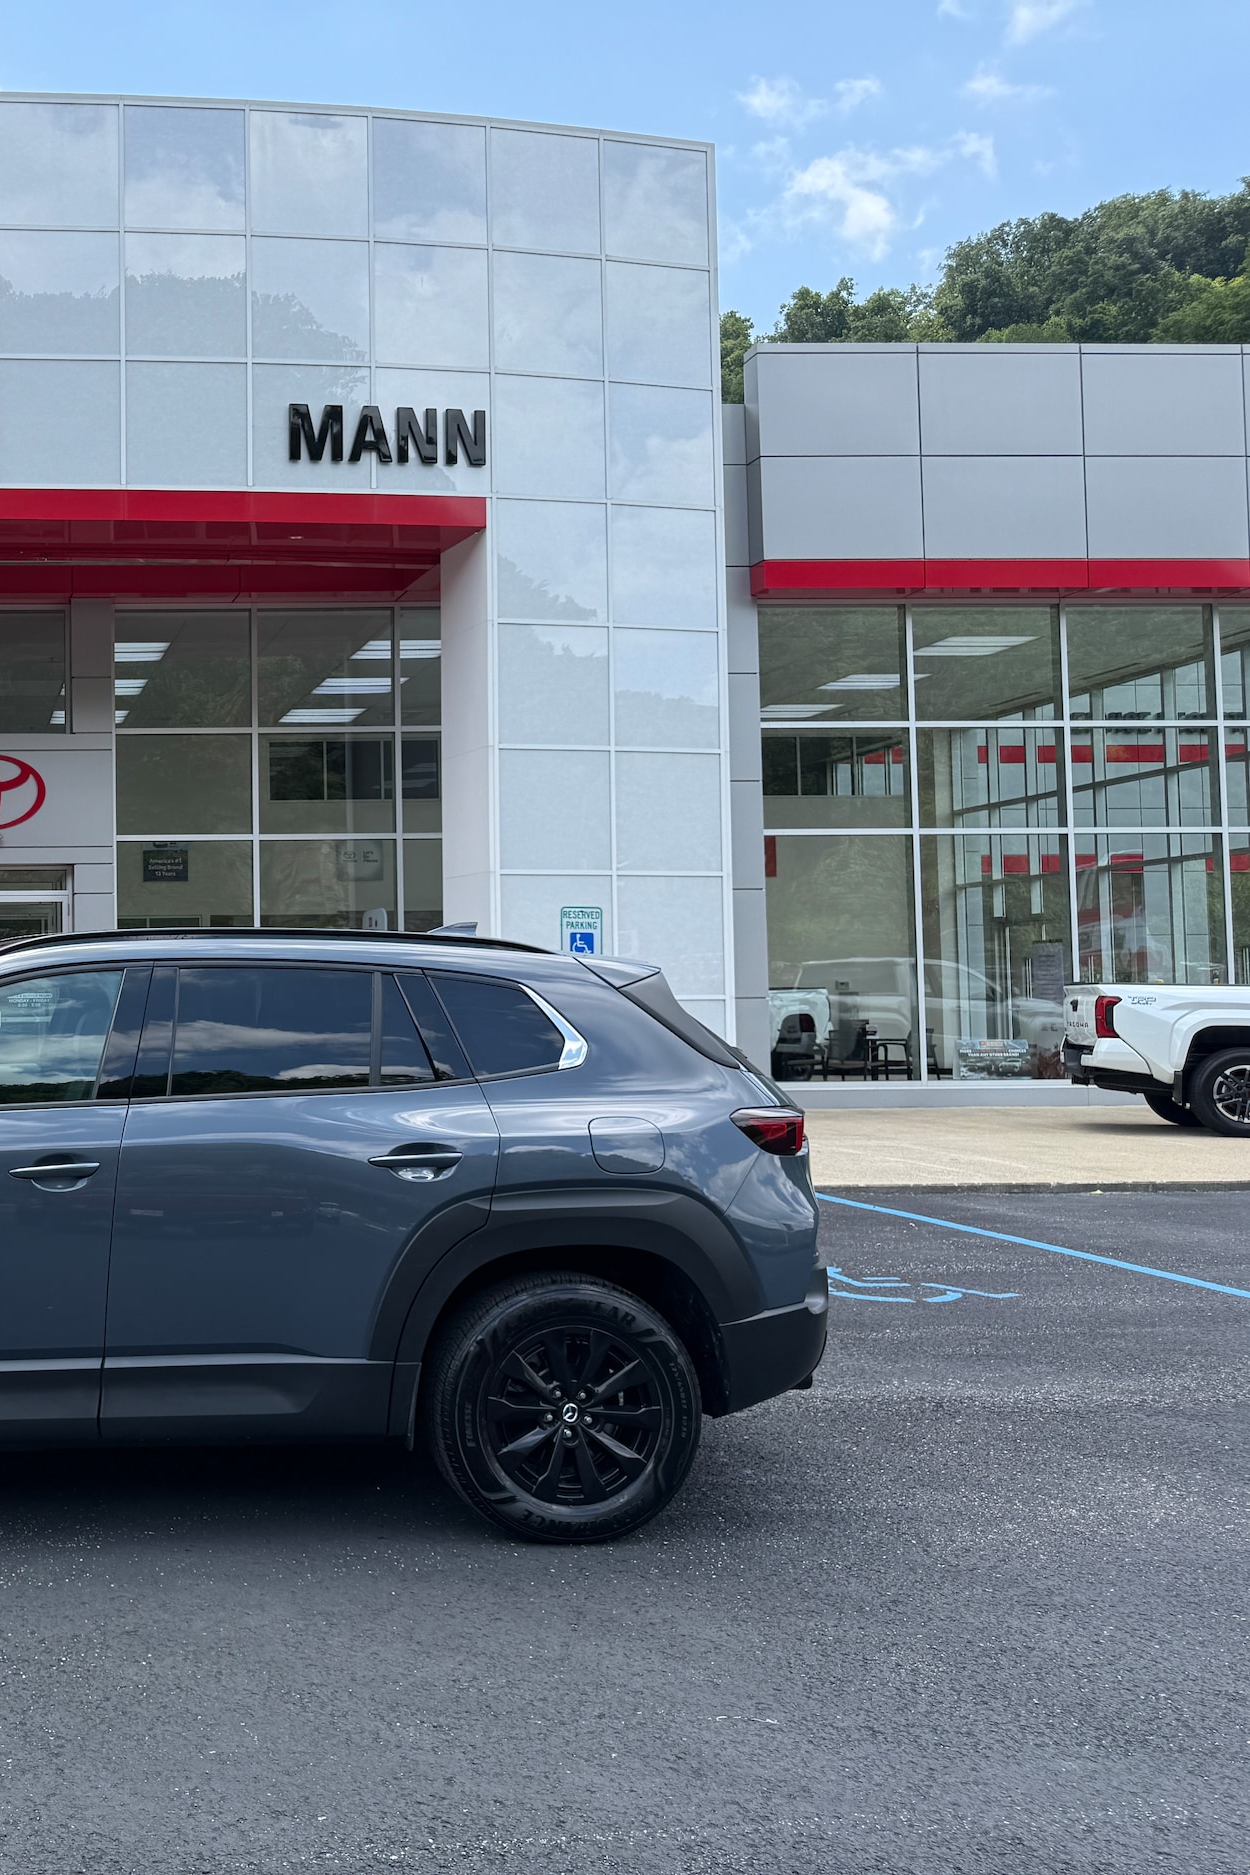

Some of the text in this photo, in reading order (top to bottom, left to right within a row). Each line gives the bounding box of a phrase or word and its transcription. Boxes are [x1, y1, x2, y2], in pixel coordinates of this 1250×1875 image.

[288, 403, 486, 466] MANN
[562, 910, 600, 919] RESERVED
[566, 921, 598, 930] PARKING
